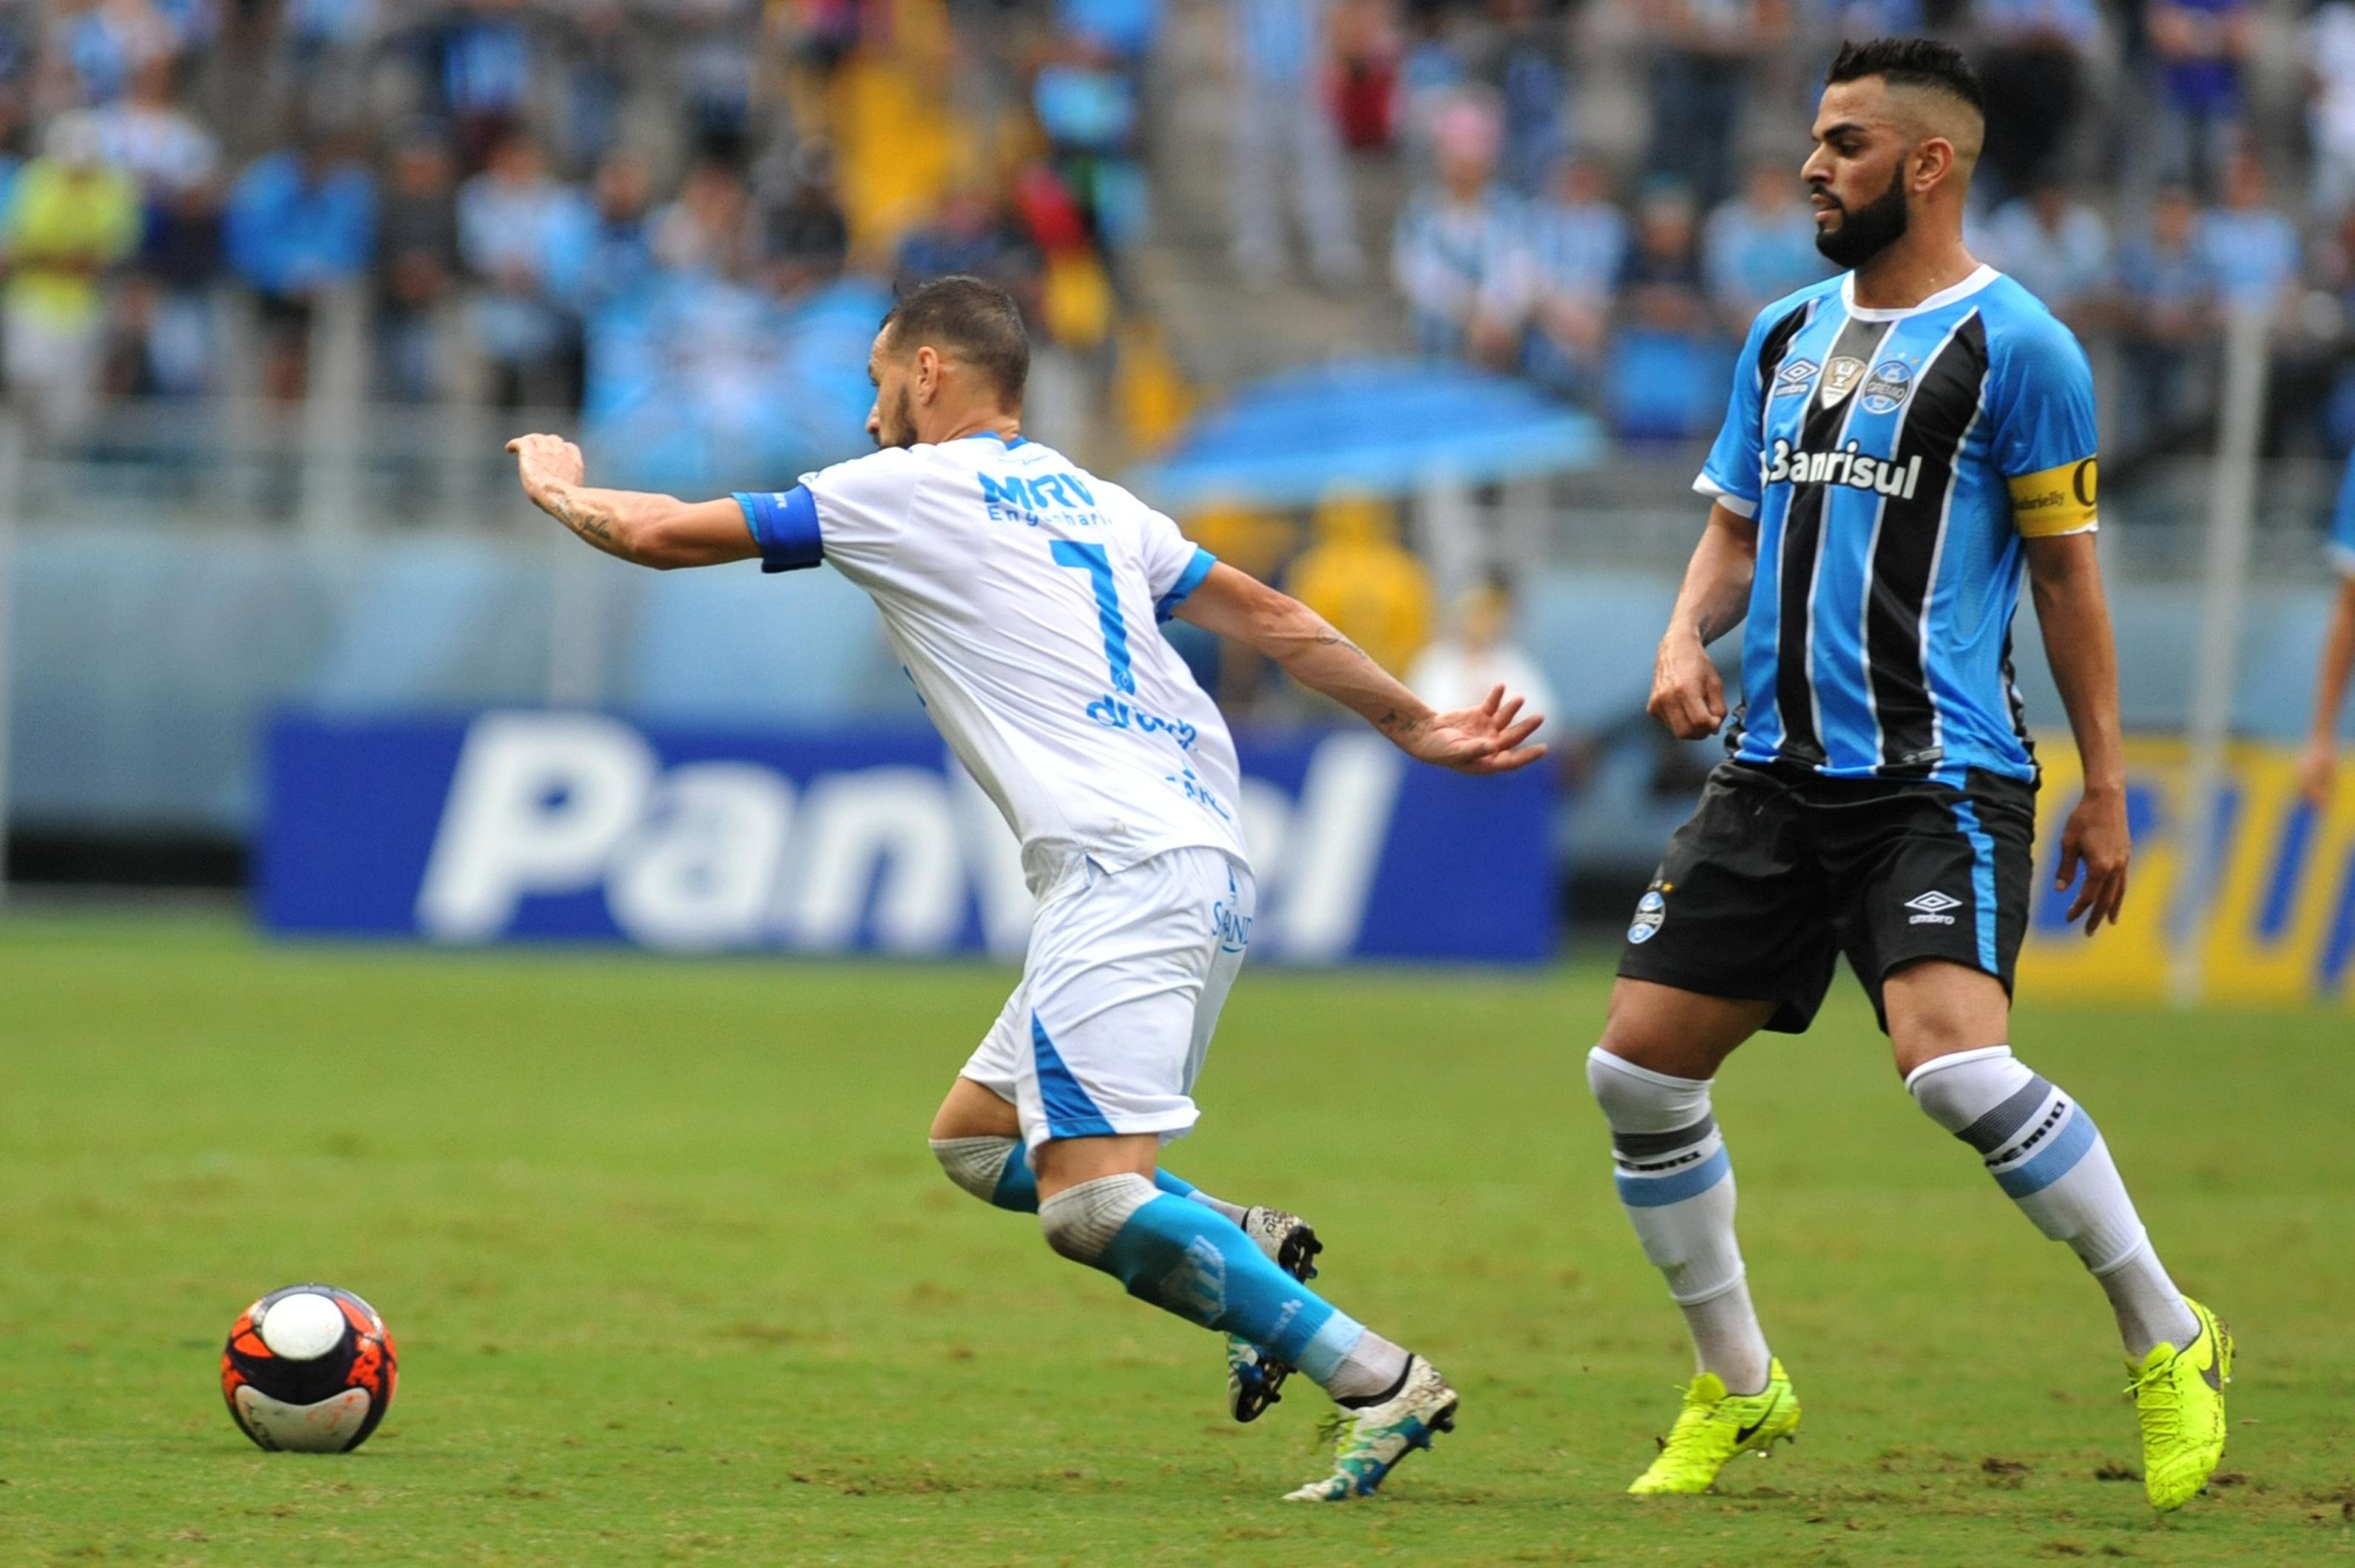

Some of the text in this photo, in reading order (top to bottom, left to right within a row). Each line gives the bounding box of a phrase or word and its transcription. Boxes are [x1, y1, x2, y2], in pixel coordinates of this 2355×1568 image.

[977, 471, 1095, 510] MRV
[1759, 439, 1922, 500] Banrisul
[1048, 539, 1136, 697] 7
[416, 712, 1399, 959] Panl
